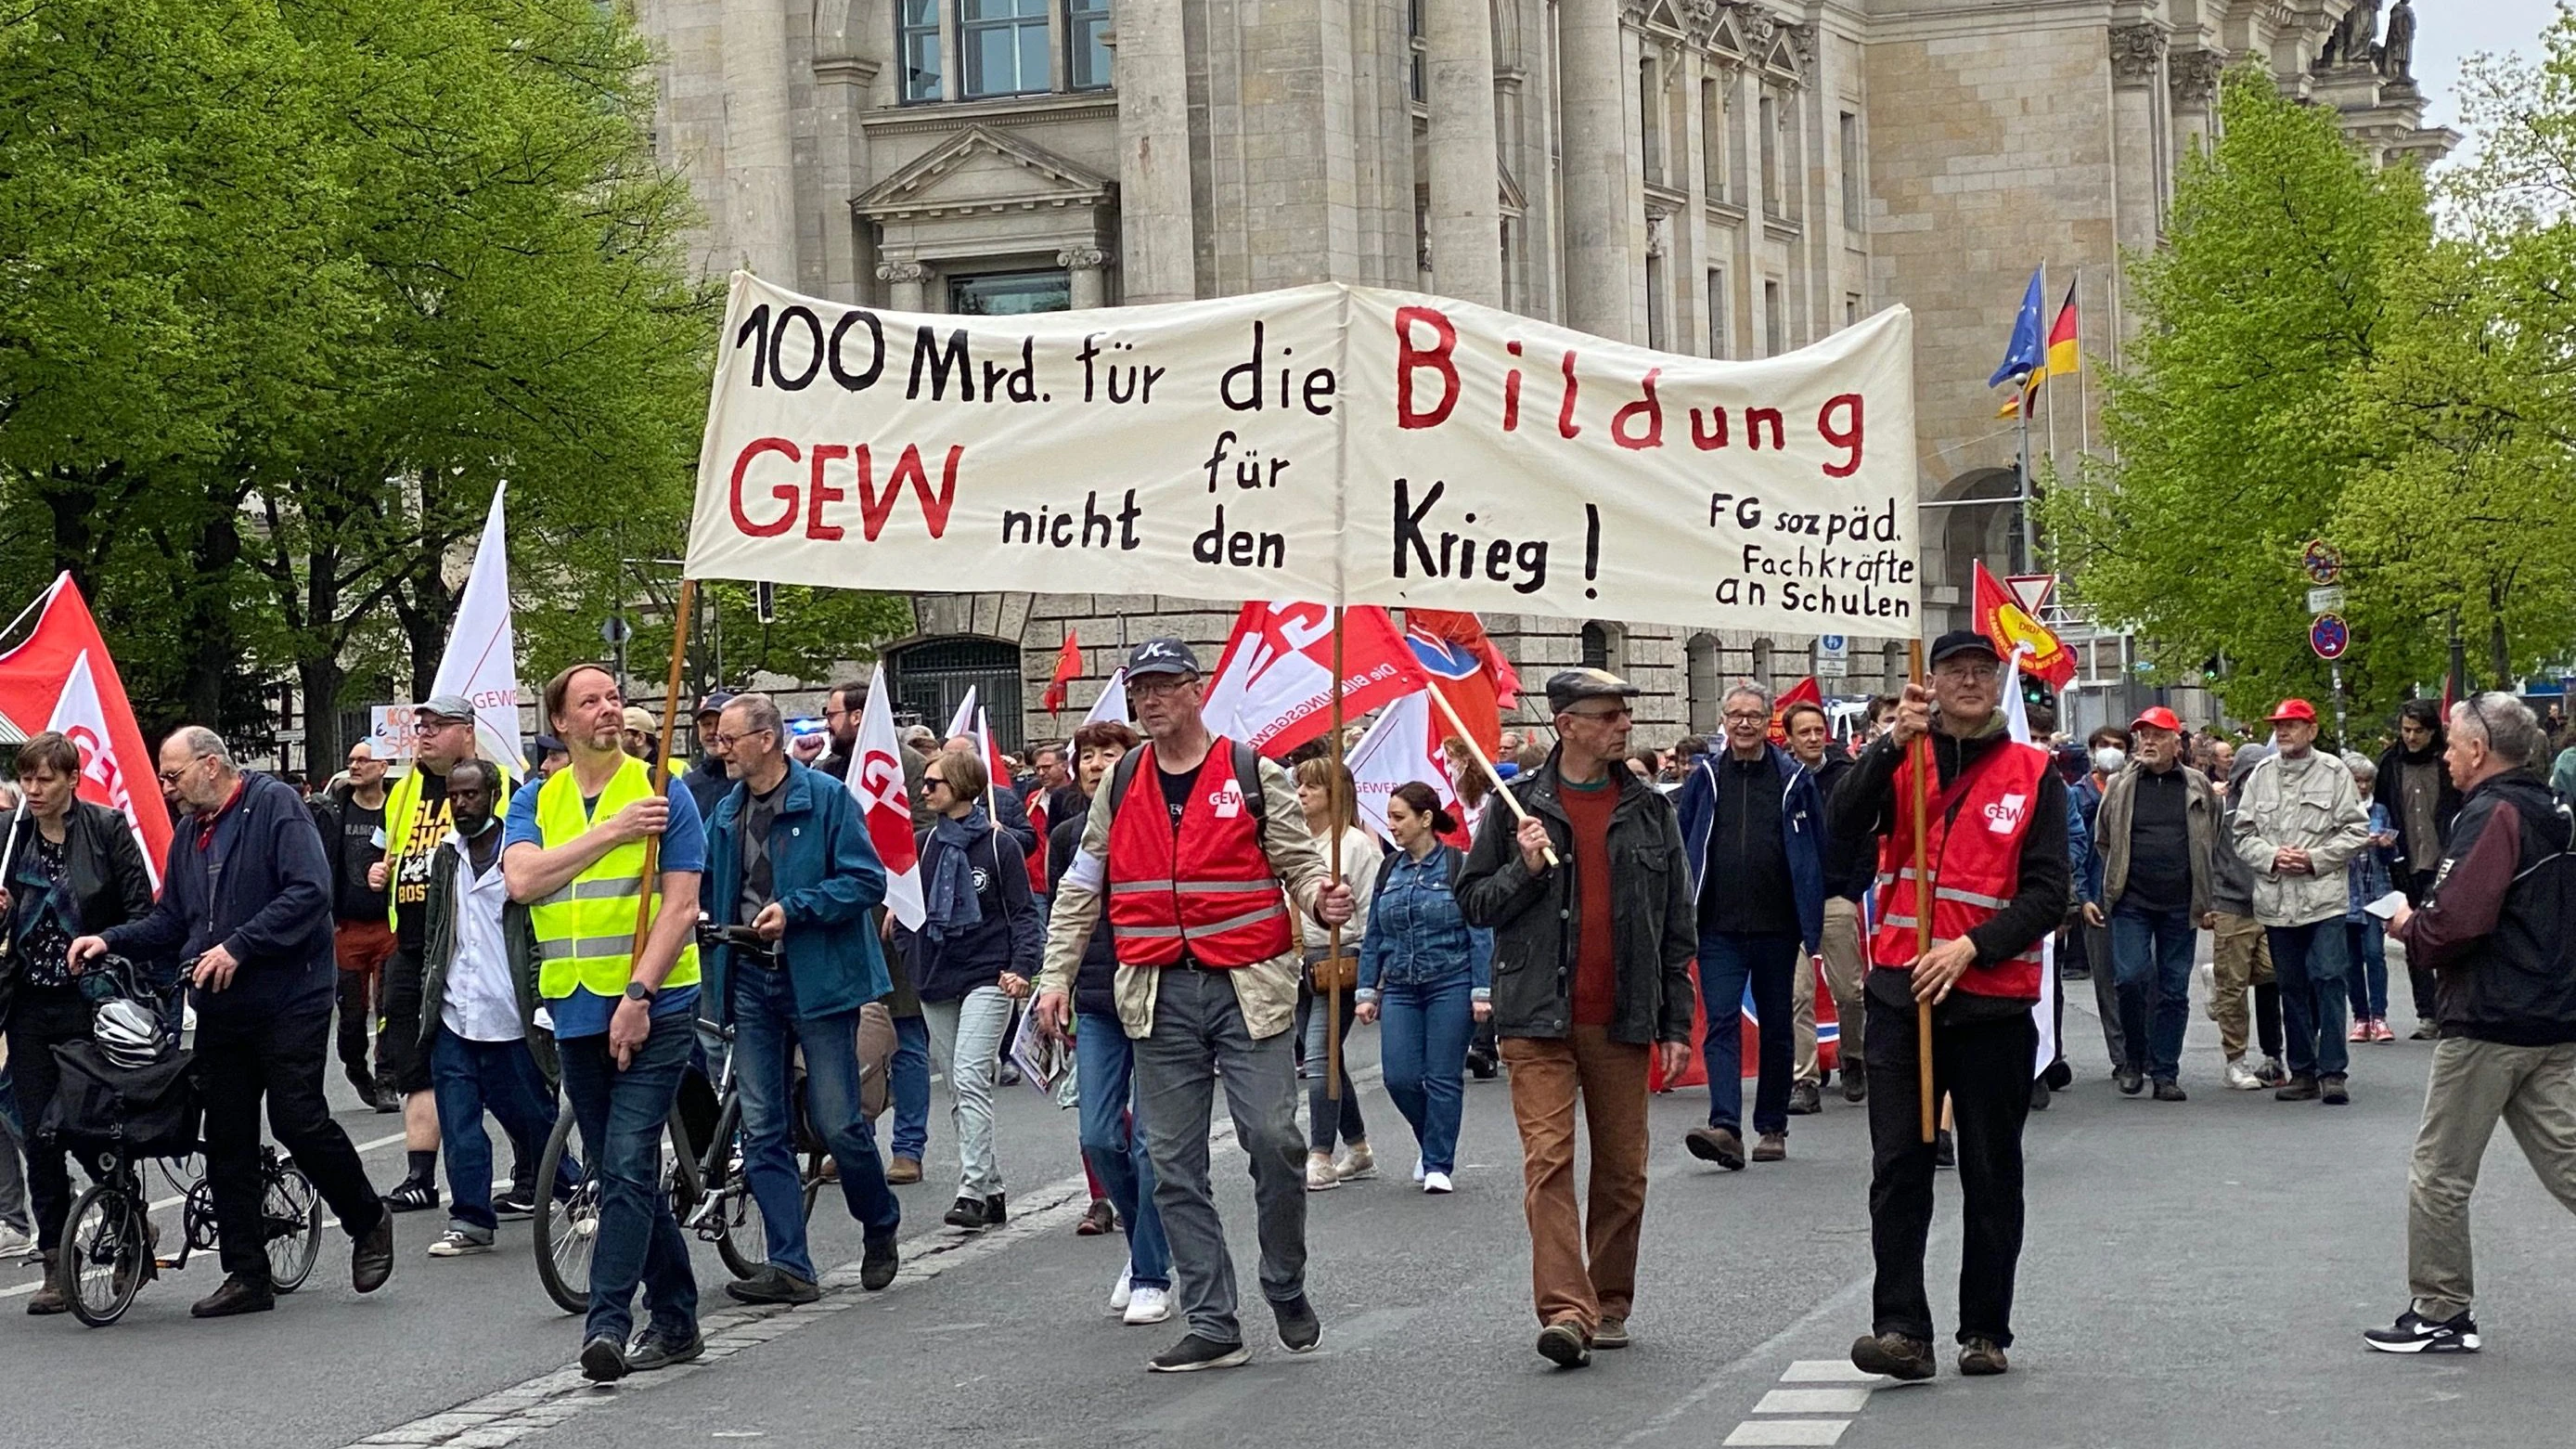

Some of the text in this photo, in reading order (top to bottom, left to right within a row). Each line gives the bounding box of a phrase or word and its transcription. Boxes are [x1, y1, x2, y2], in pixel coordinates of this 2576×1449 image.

[737, 304, 1863, 477] 100 Mrd. für die Bildung
[1204, 430, 1290, 493] für
[729, 436, 964, 542] GEW
[1002, 488, 1141, 550] nicht
[1192, 504, 1285, 568] den
[1393, 478, 1549, 594] Krieg
[1709, 493, 1761, 529] FG
[1743, 545, 1914, 584] Fachkräfte
[1716, 577, 1910, 618] an Schulen
[1984, 802, 2026, 823] GEW
